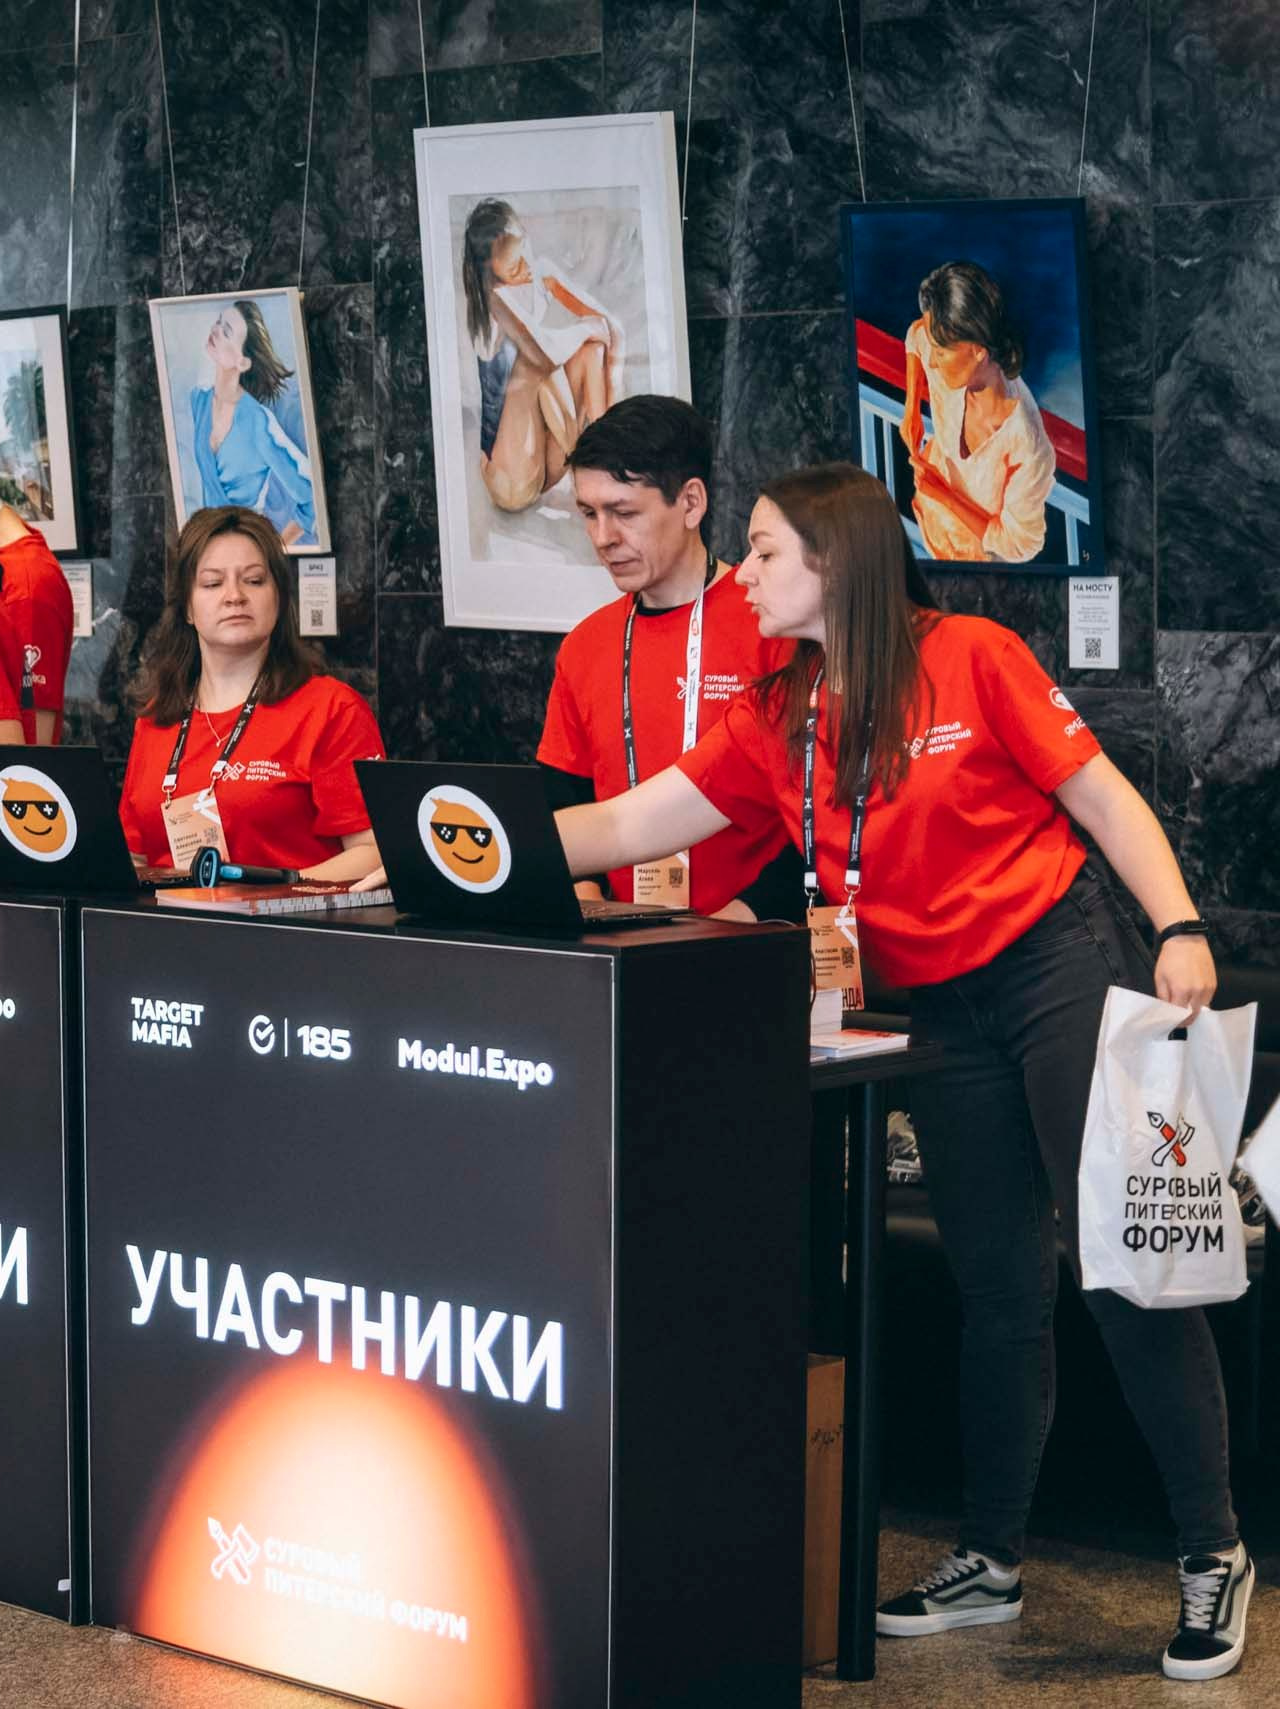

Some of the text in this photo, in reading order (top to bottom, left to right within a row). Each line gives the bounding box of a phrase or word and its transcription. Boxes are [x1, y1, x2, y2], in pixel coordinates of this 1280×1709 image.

[1073, 584, 1113, 592] НА МОСТУ
[704, 674, 738, 683] СУРОВЫЙ
[703, 692, 730, 700] ФОРУМ
[928, 743, 956, 755] ФОРУМ
[247, 767, 287, 778] ПИТЕРСКИЙ
[249, 760, 281, 770] СУРОВЫЙ
[131, 997, 204, 1027] TARGET
[131, 1020, 193, 1049] MAFIA
[297, 1024, 352, 1061] 185
[398, 1037, 554, 1091] Modul.Expo
[1122, 1223, 1224, 1254] ФОРУМ
[125, 1244, 563, 1411] УЧАСТНИКИ
[388, 1599, 468, 1643] ФОРУМ
